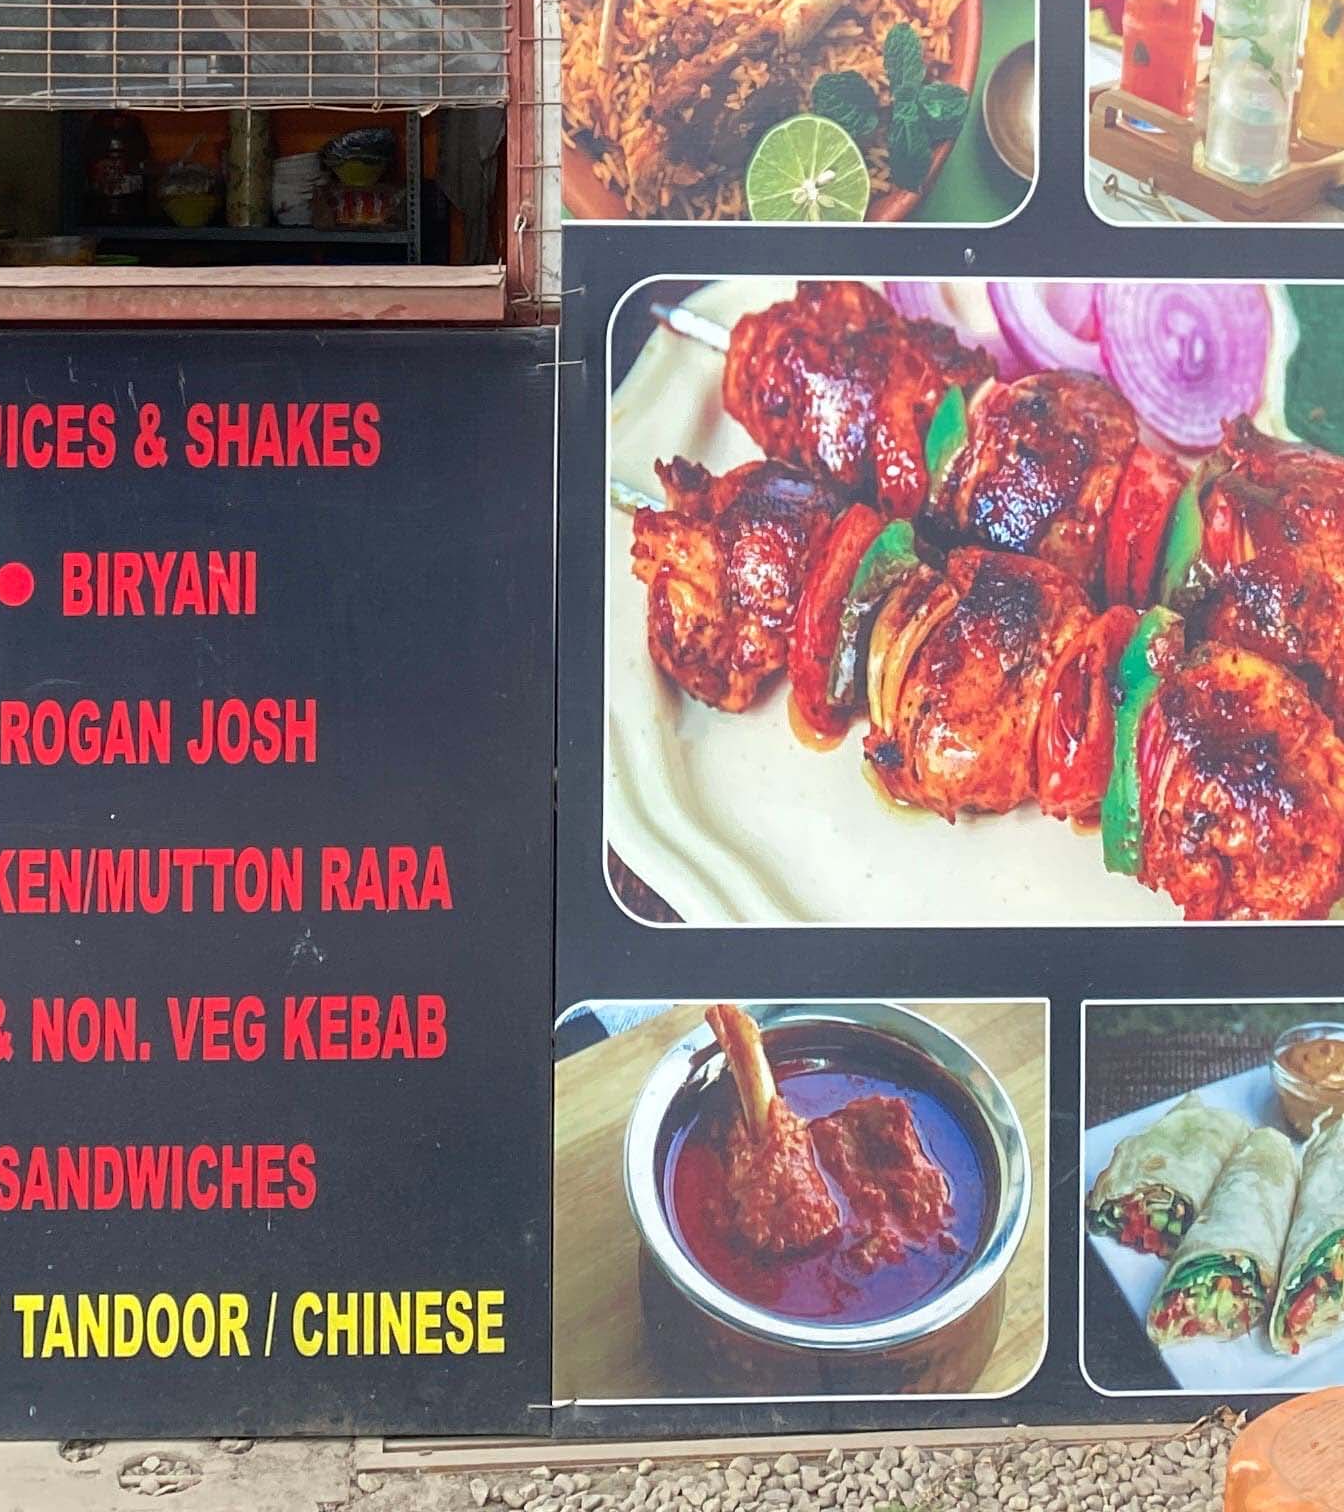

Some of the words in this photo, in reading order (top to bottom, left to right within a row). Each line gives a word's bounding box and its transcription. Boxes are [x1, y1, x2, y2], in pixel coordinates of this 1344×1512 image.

[134, 404, 168, 468] &
[186, 403, 380, 467] SHAKES
[63, 551, 256, 616] BIRYANI
[0, 699, 170, 765] ROGAN
[187, 698, 316, 764] JOSH
[321, 846, 452, 911] RARA
[32, 997, 151, 1062] NON.
[167, 996, 266, 1061] VEG
[284, 995, 447, 1060] KEBAB
[14, 1293, 250, 1358] TANDOOR
[293, 1290, 505, 1356] CHINESE
